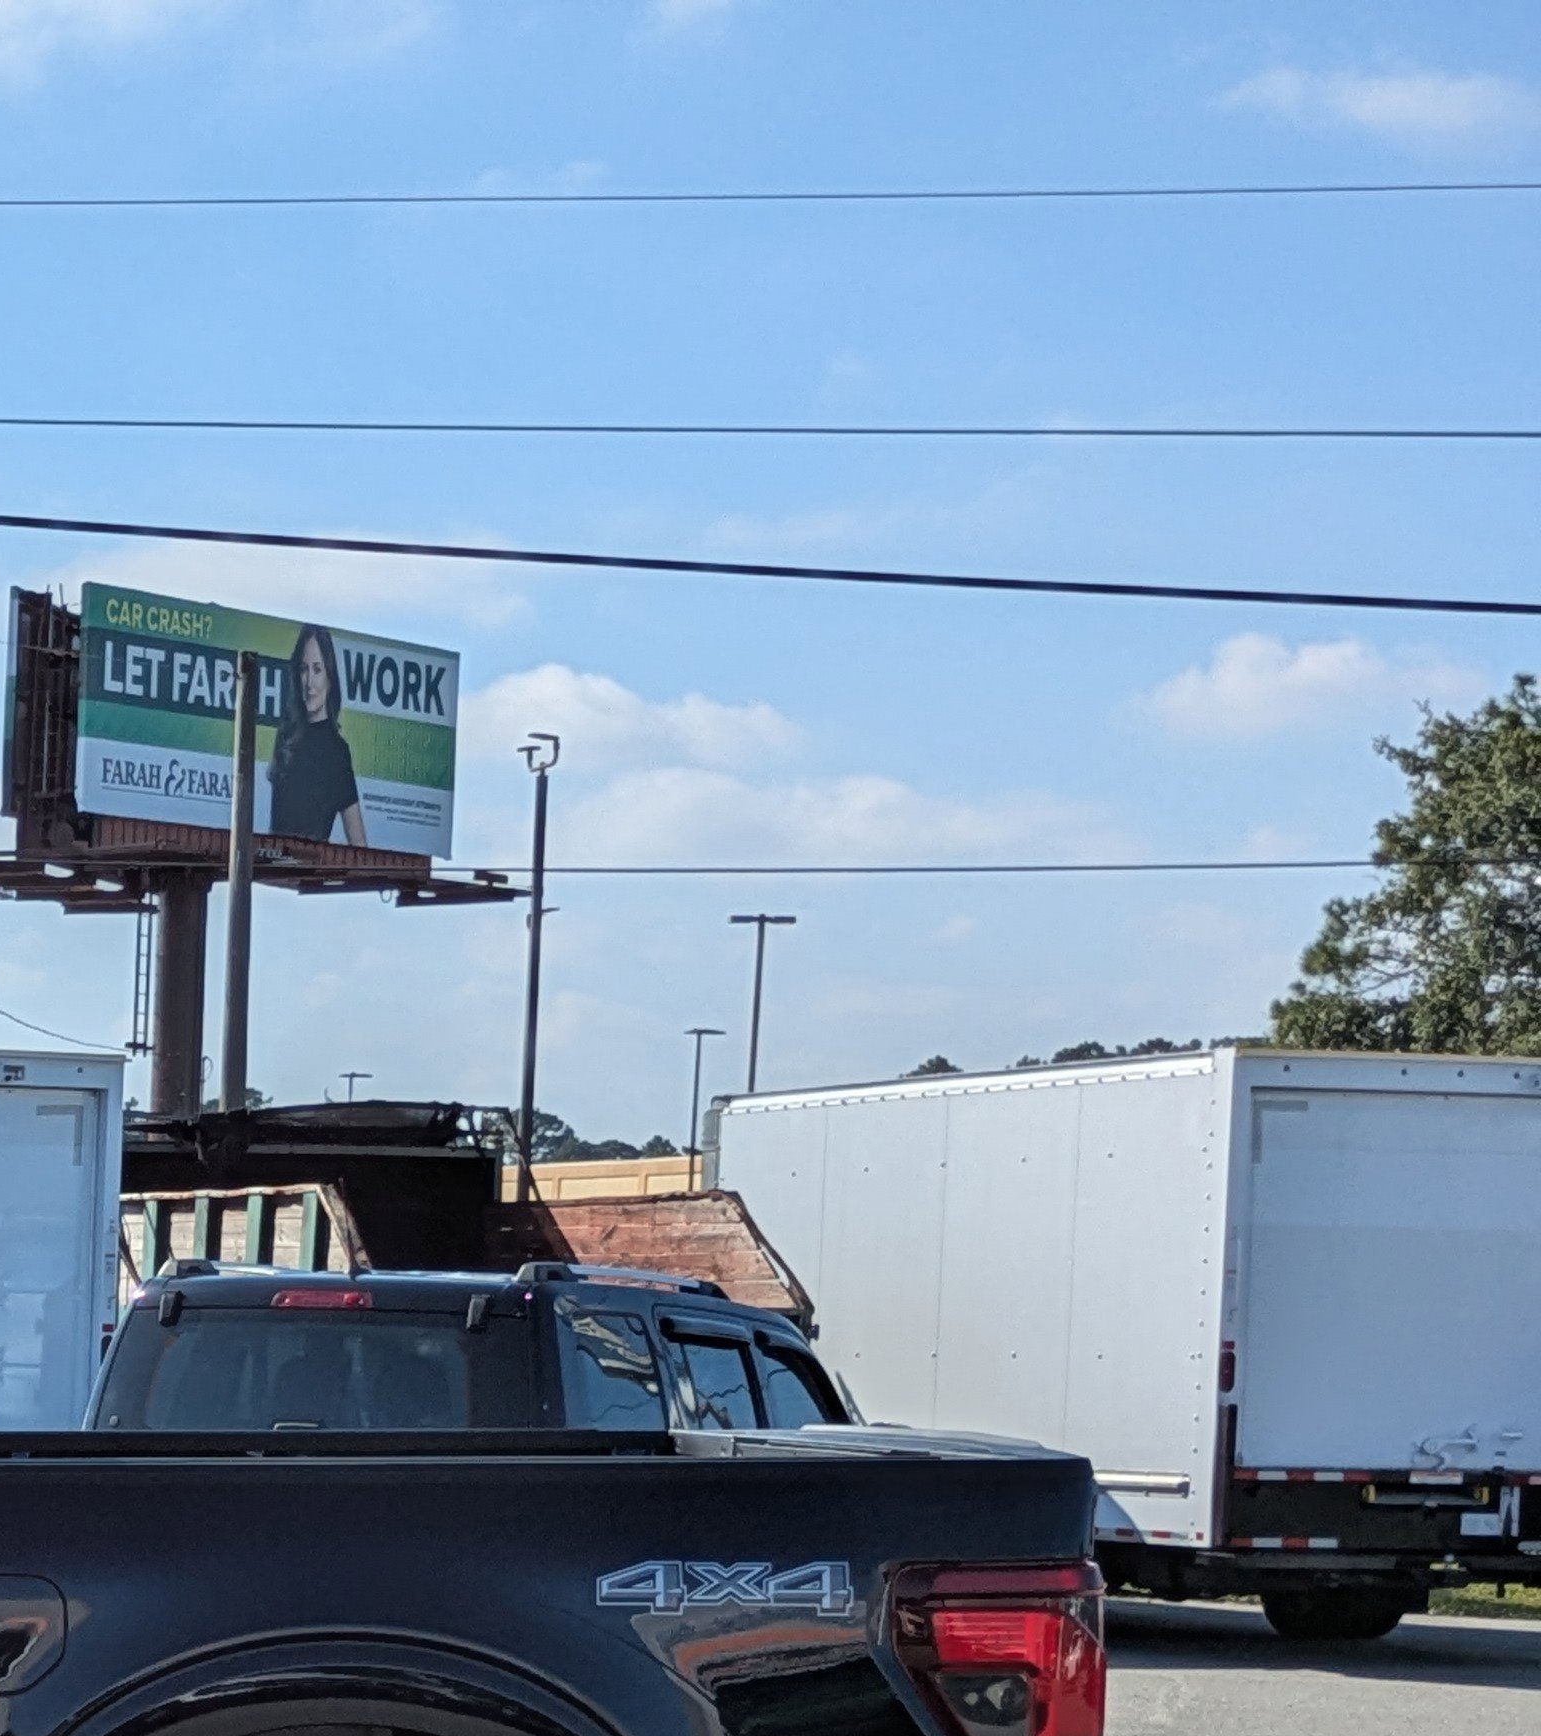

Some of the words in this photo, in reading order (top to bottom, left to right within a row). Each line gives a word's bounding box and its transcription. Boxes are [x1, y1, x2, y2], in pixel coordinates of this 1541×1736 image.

[106, 599, 143, 629] CAR
[147, 606, 213, 639] CRASH?
[104, 641, 165, 699] LET
[172, 652, 282, 718] FARH
[343, 649, 445, 716] WORK
[102, 758, 162, 789] FARAH
[188, 768, 234, 798] FARA
